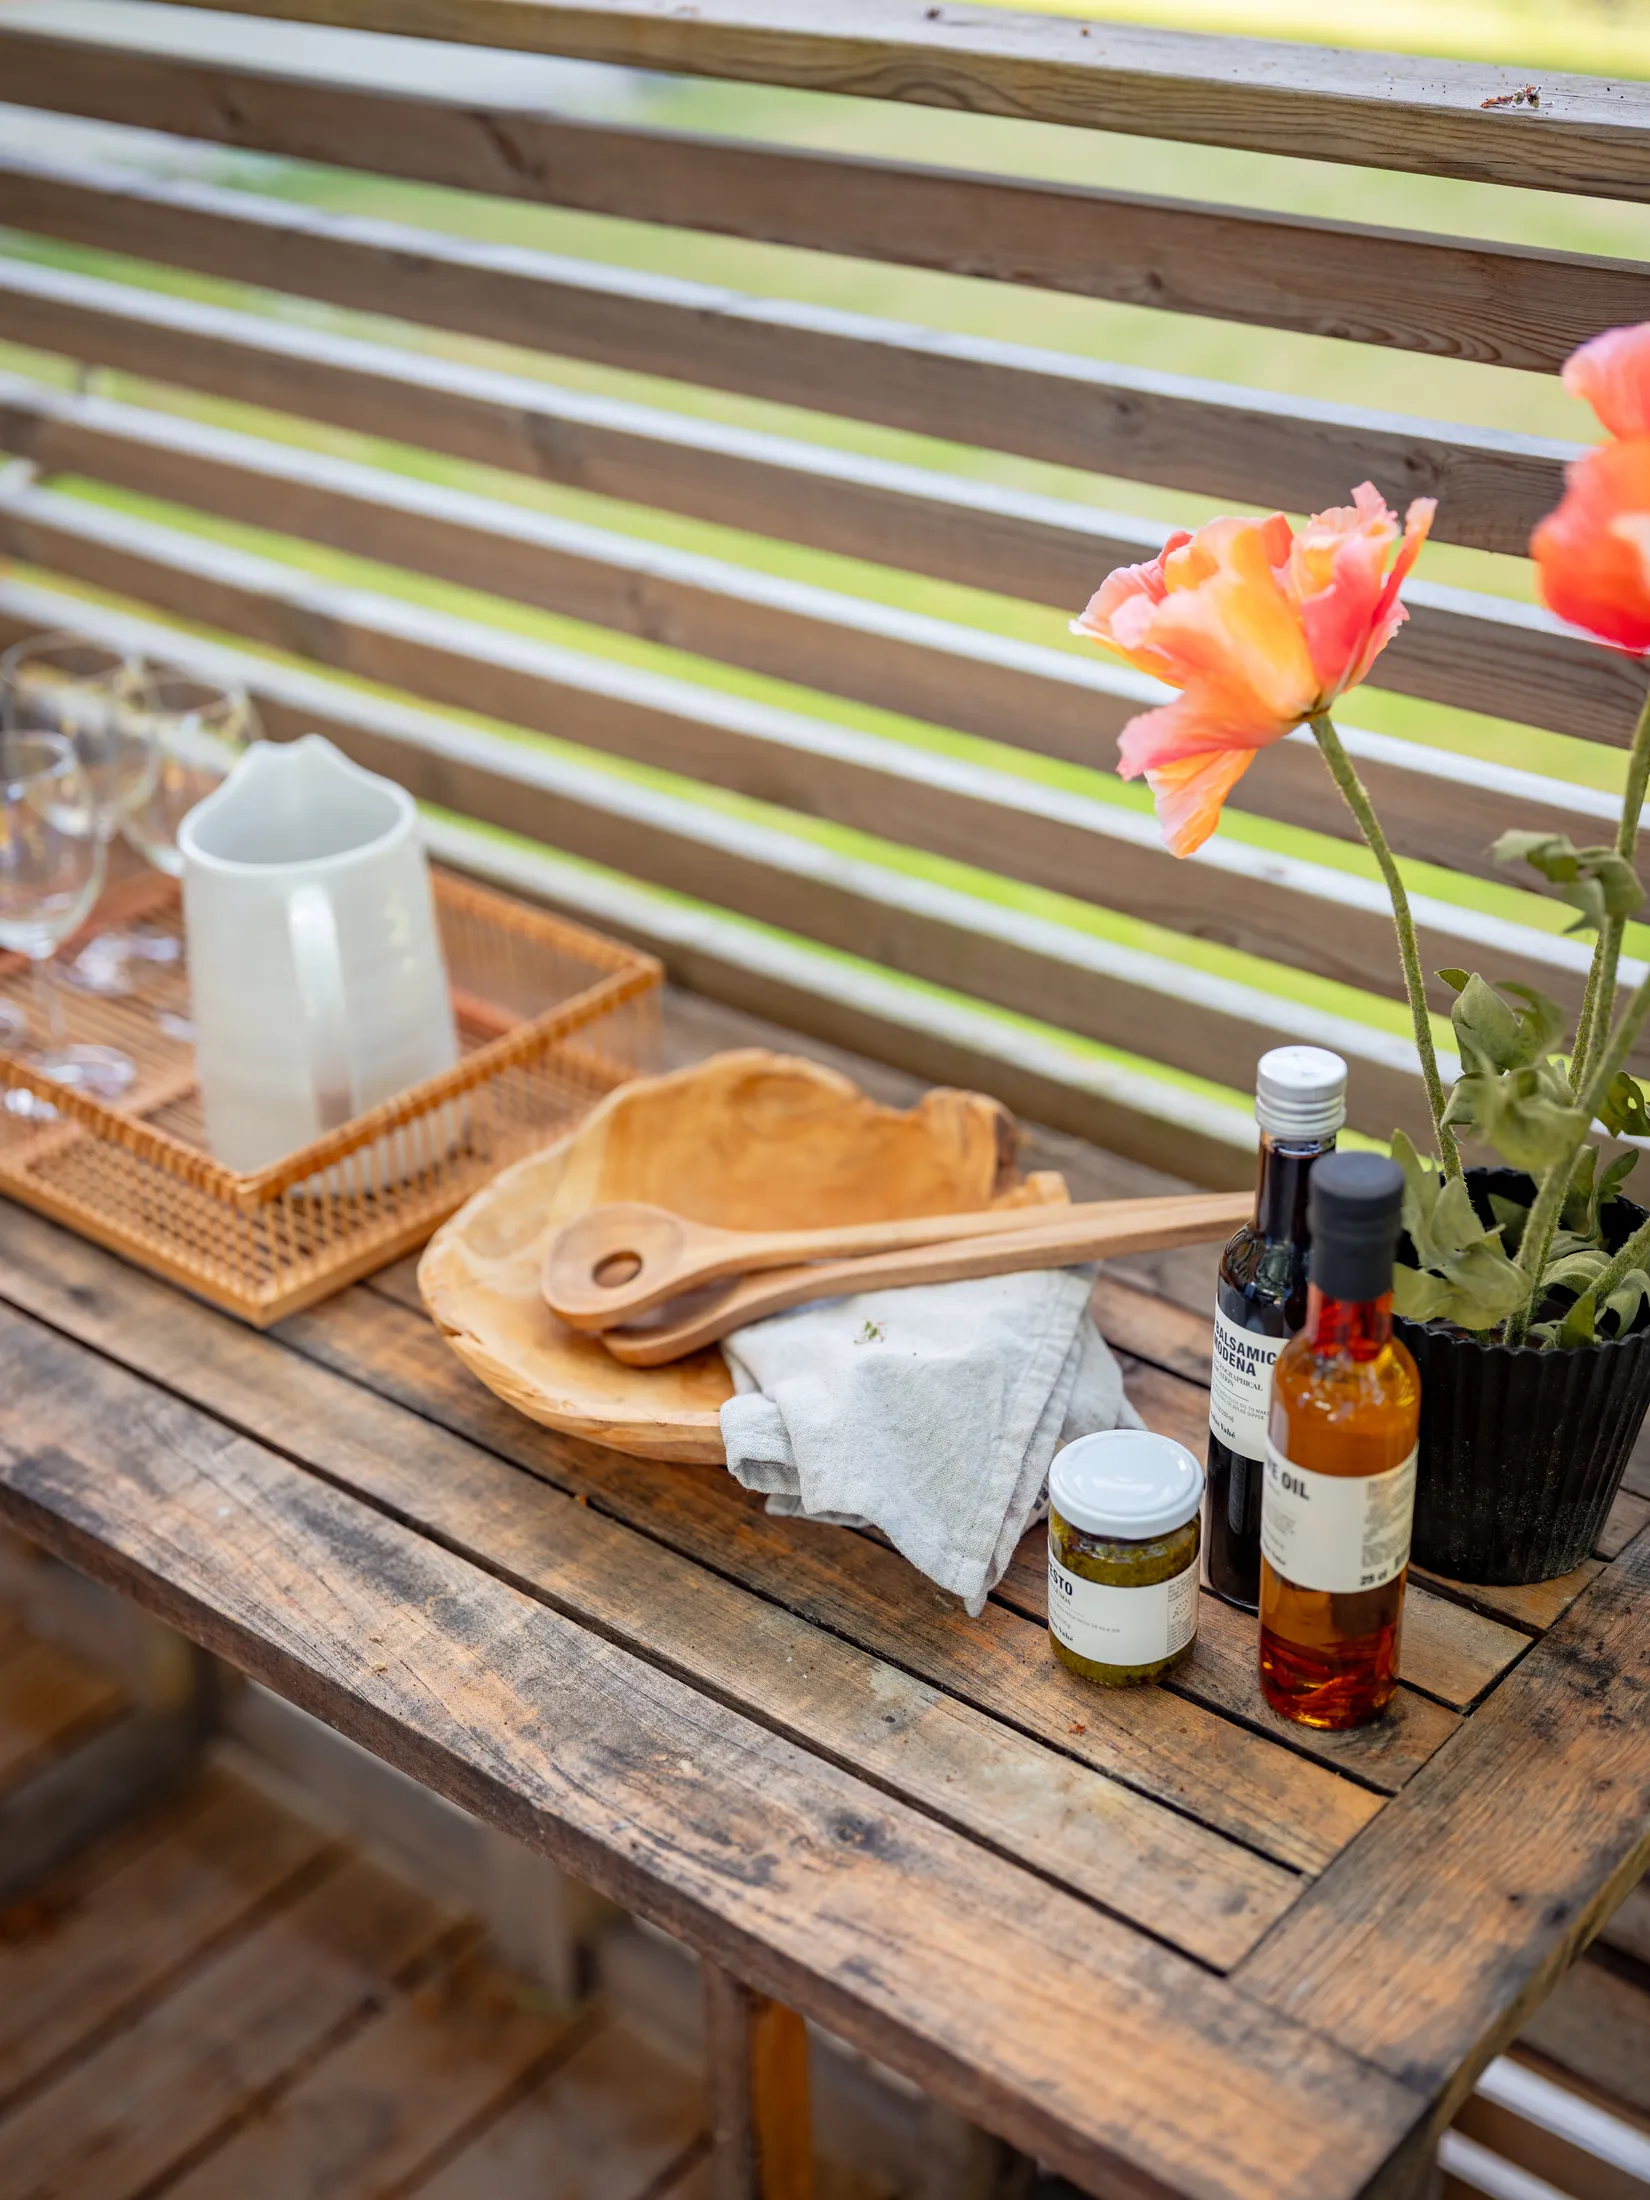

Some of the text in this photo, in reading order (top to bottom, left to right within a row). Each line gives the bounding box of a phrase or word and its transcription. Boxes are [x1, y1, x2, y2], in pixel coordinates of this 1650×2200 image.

[1216, 1320, 1278, 1366] BALSAMIC
[1282, 1471, 1310, 1500] OIL
[1048, 1561, 1073, 1596] ESTO
